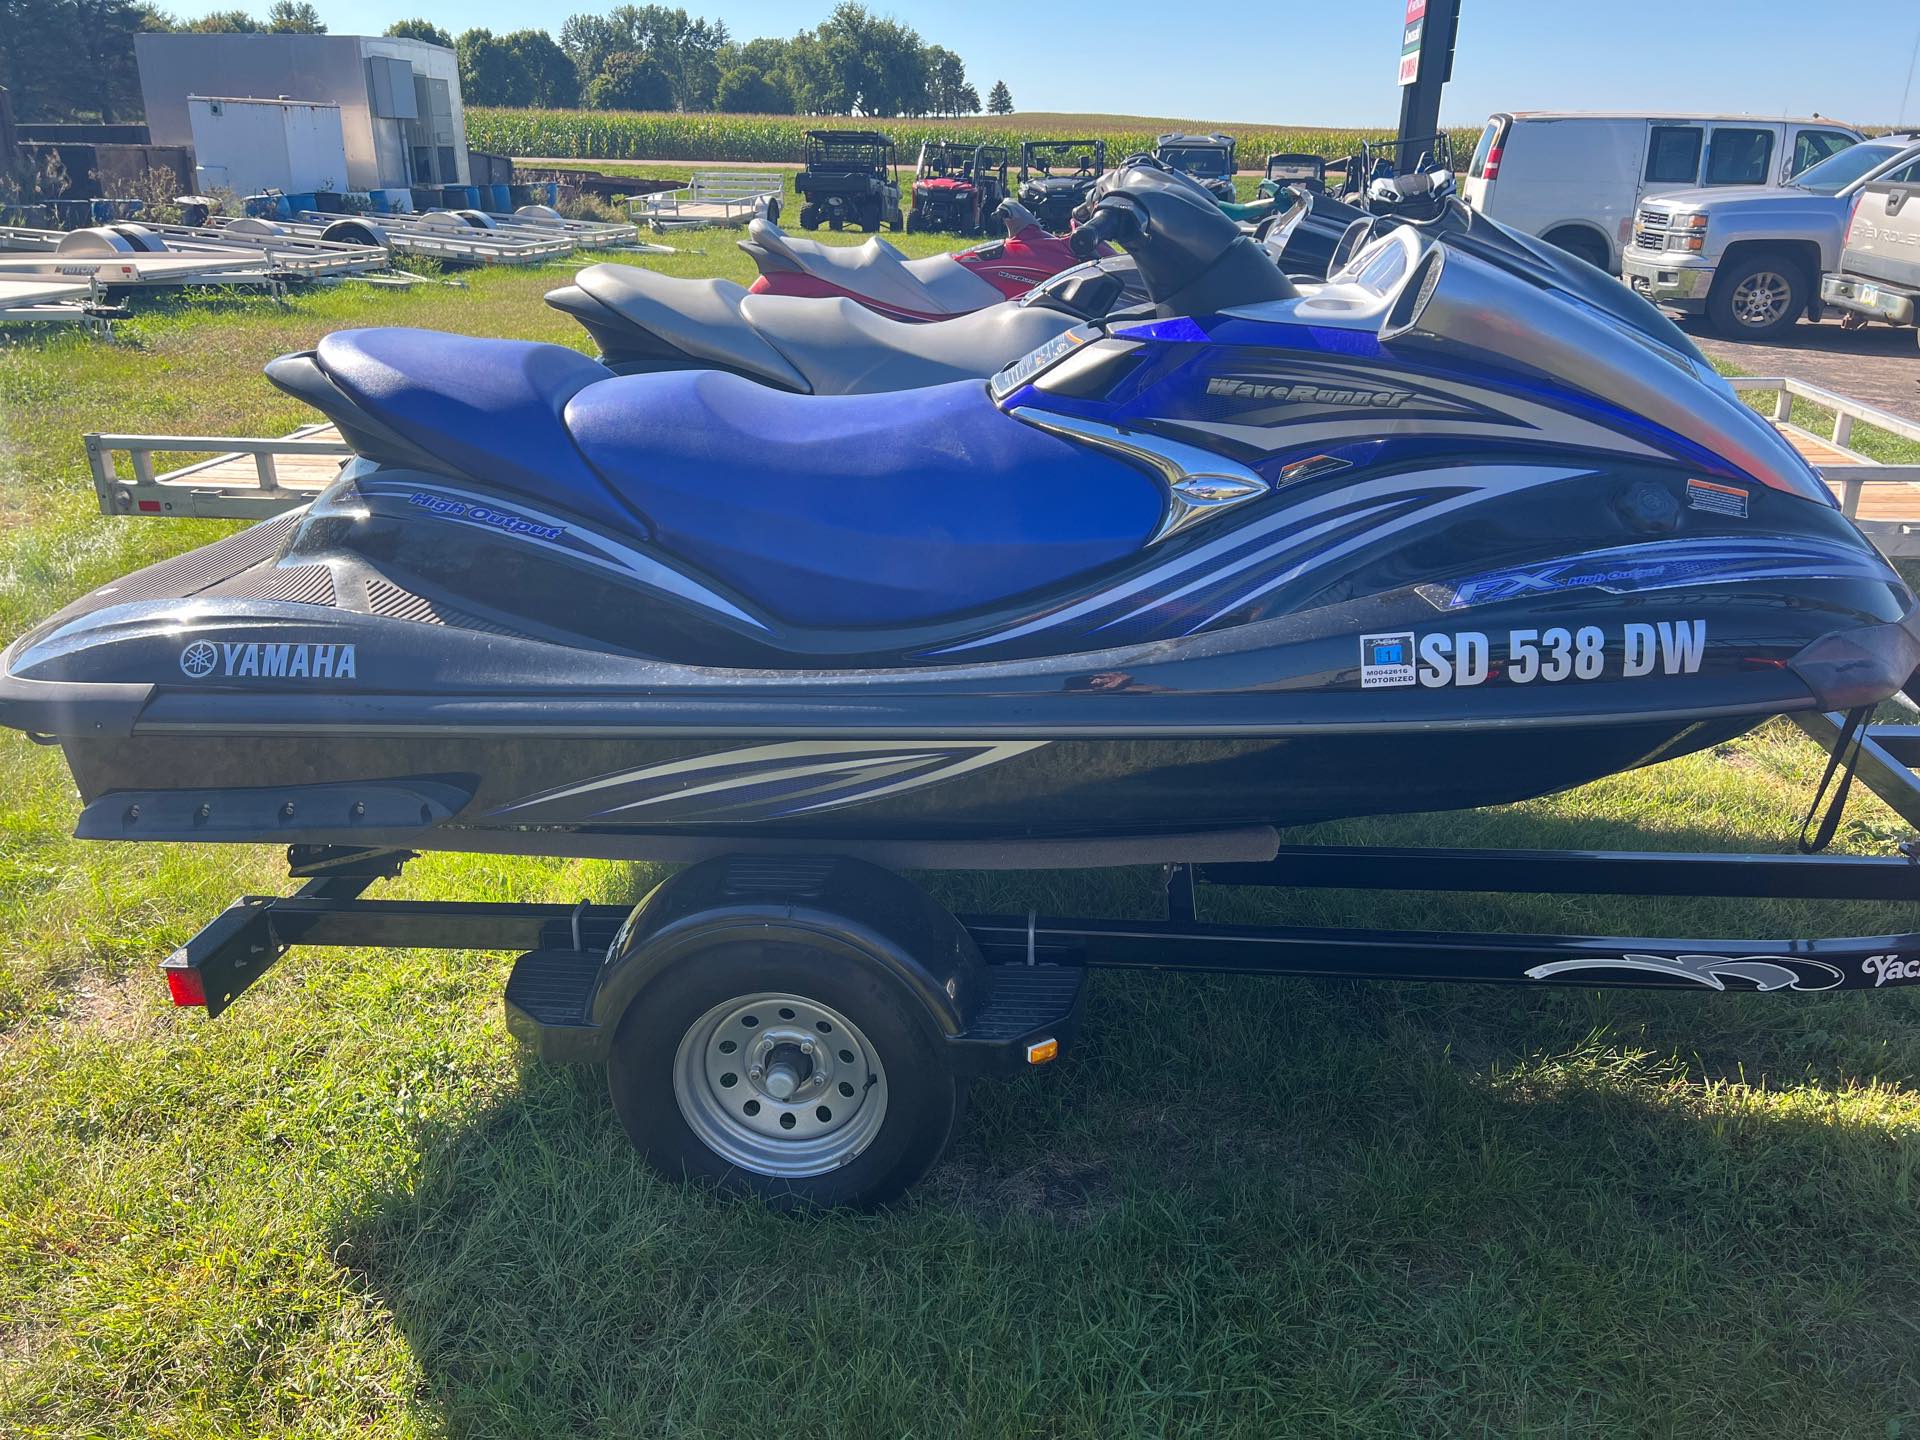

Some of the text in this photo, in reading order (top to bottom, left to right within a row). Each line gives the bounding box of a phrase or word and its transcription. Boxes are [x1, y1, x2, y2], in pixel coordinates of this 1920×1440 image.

[1853, 223, 1920, 250] CHEVROLE
[1206, 377, 1413, 408] WaveRunner
[408, 492, 566, 540] High Output
[1451, 564, 1576, 606] FX
[223, 643, 357, 679] YAMAHA
[1419, 619, 1706, 688] SD 538 DW
[1364, 675, 1415, 684] MOTORIZED
[1861, 954, 1920, 987] Yac
